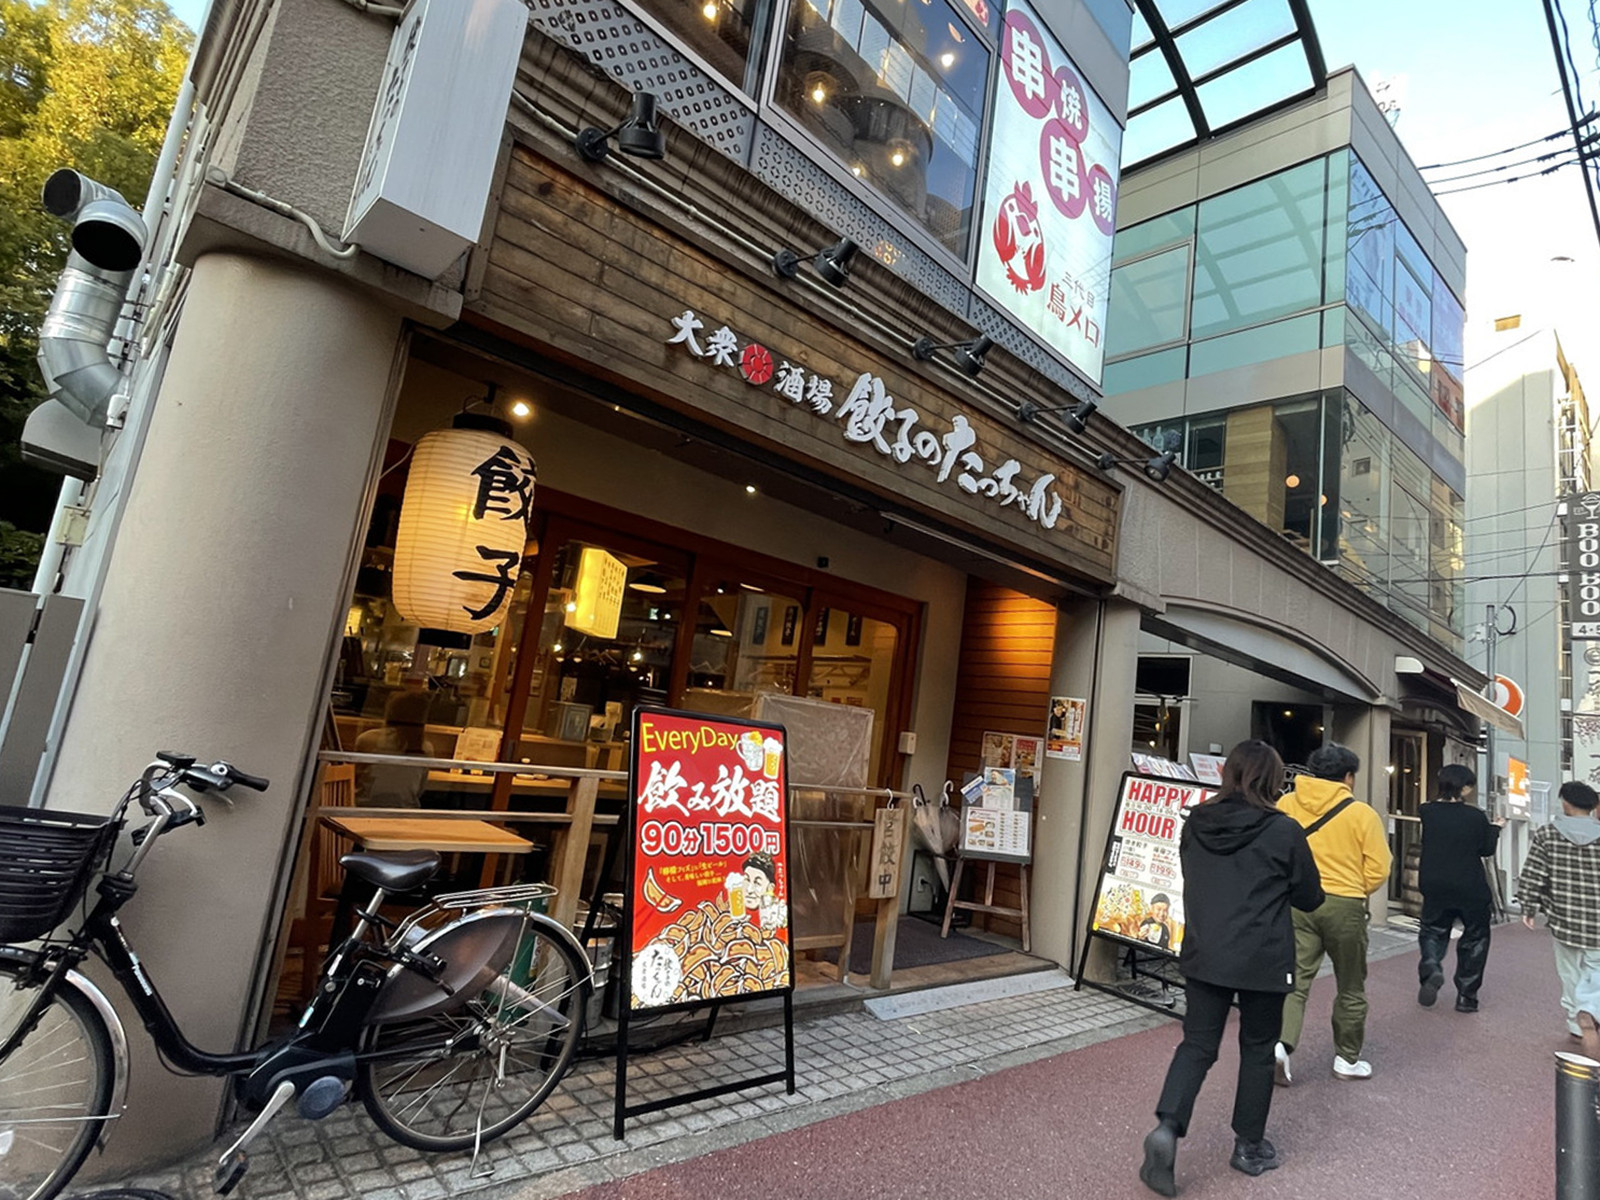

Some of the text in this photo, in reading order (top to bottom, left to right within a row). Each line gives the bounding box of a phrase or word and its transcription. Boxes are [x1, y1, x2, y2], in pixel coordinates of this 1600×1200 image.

[1011, 26, 1084, 131] 串焼
[1049, 136, 1113, 224] 串揚
[1046, 283, 1101, 349] 鳥メロ
[1061, 271, 1097, 308] 三代目
[665, 310, 738, 368] 大衆
[773, 360, 834, 415] 酒場
[452, 445, 537, 620] 餃子
[642, 722, 738, 754] EveryDay
[637, 760, 781, 823] 飲み放題
[1128, 780, 1192, 808] HAPPY
[1121, 810, 1175, 839] HOUR
